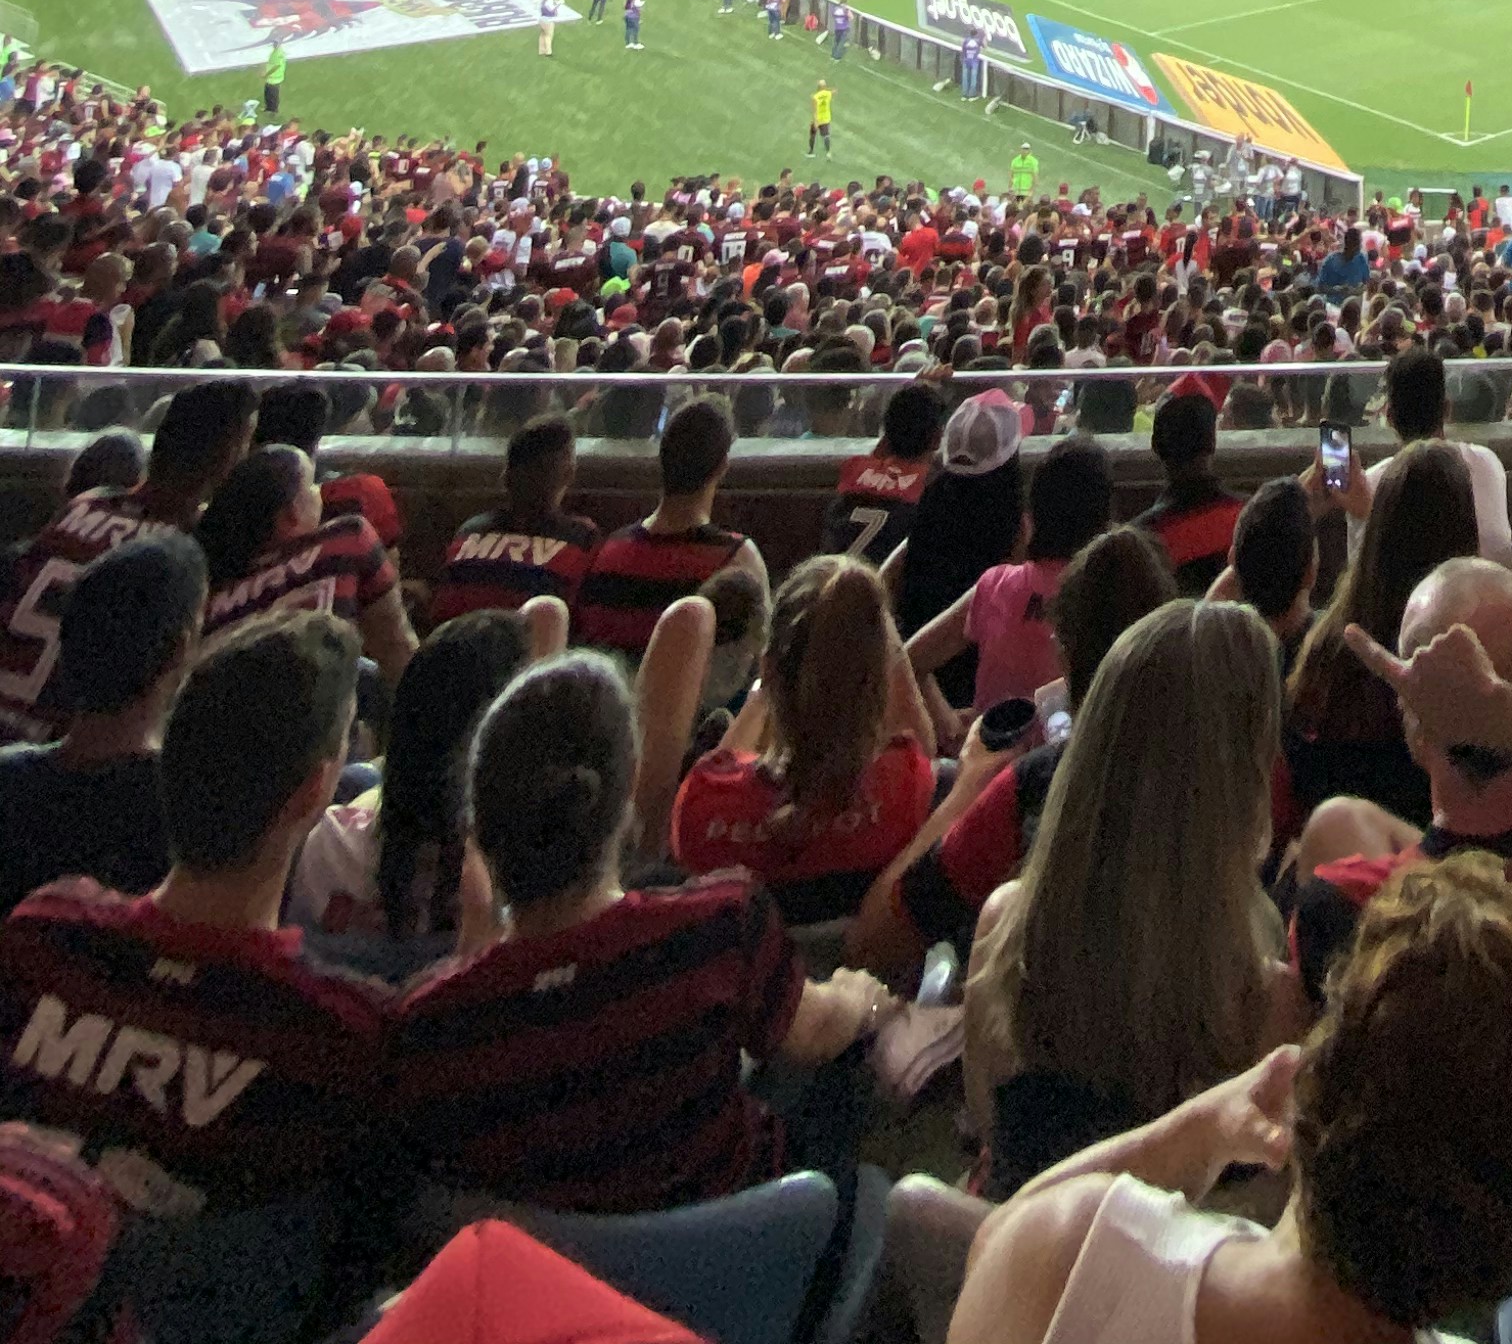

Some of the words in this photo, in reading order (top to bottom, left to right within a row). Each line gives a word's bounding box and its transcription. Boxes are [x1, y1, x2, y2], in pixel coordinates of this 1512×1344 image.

[1051, 39, 1141, 99] WIZARD
[455, 532, 568, 566] MRV
[849, 506, 890, 559] 7
[11, 992, 269, 1127] MRV
